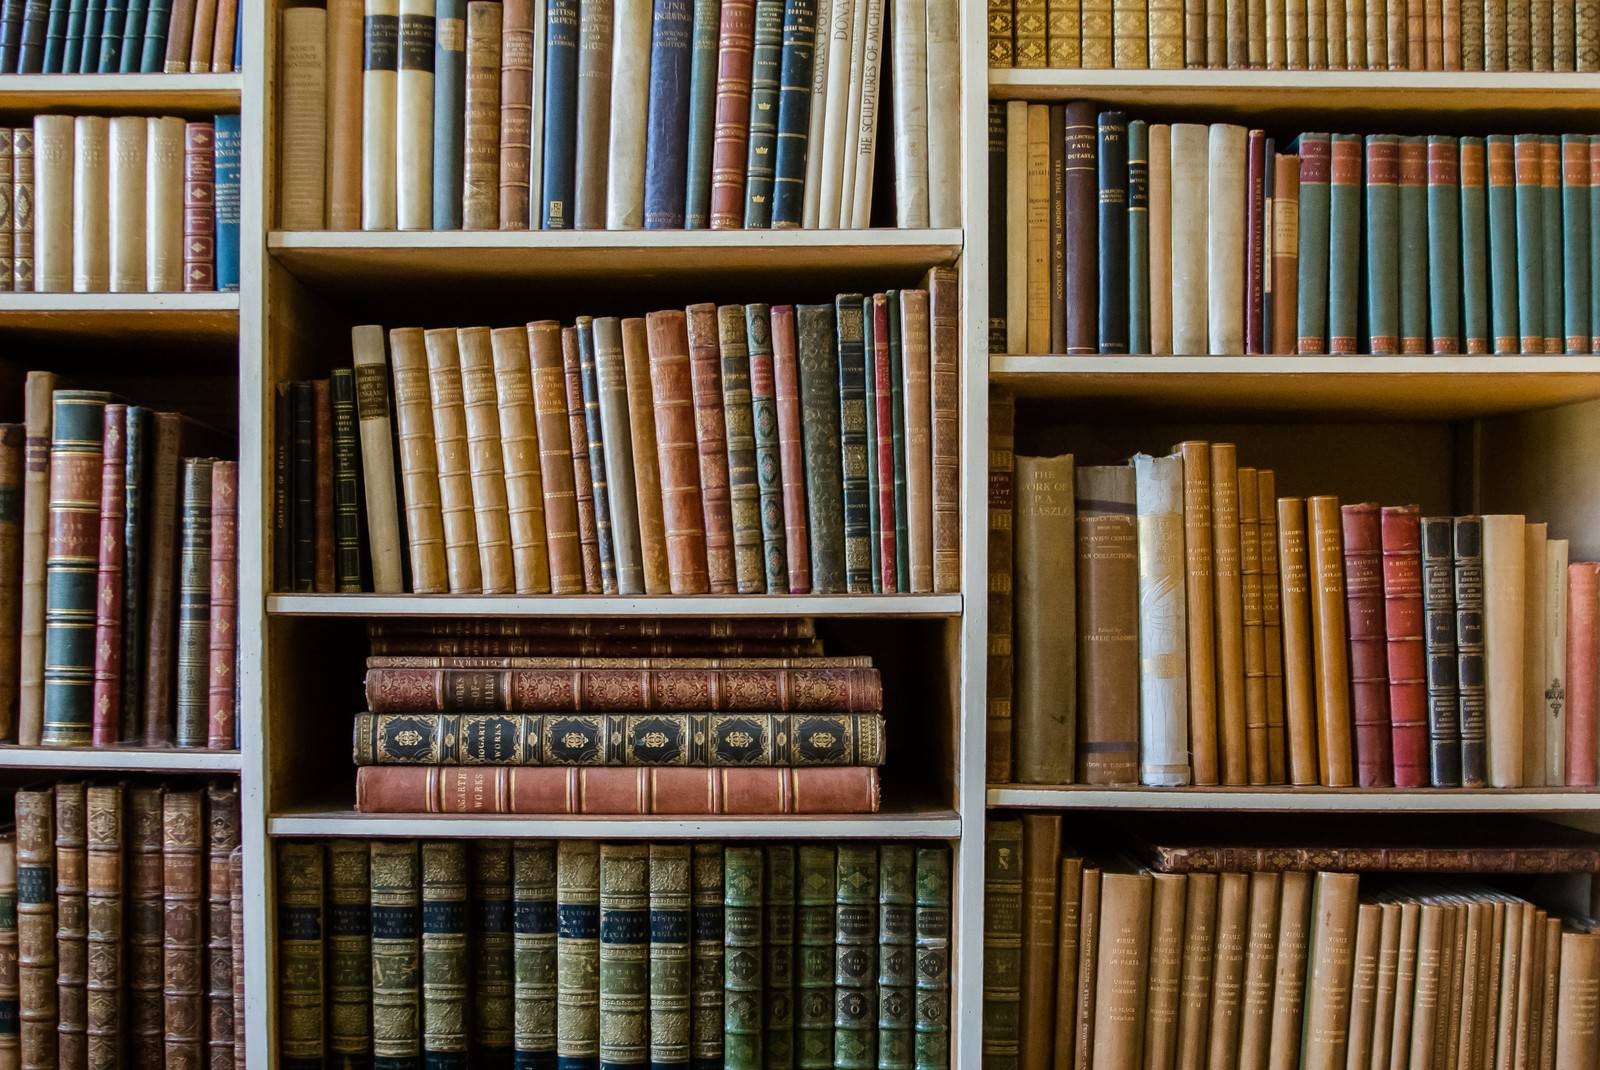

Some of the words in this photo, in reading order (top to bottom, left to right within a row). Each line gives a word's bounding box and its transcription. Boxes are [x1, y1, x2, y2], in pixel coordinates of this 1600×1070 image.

[663, 1, 686, 10] LINE
[867, 46, 879, 62] OF
[814, 42, 827, 95] ROMAN
[863, 66, 877, 137] SCULPTURES
[860, 133, 873, 156] THE
[1105, 134, 1120, 142] ART
[1055, 200, 1063, 229] LONDON
[1056, 250, 1063, 259] OF
[1034, 470, 1056, 479] THE
[493, 722, 503, 758] WORKS
[473, 773, 485, 808] WORKS
